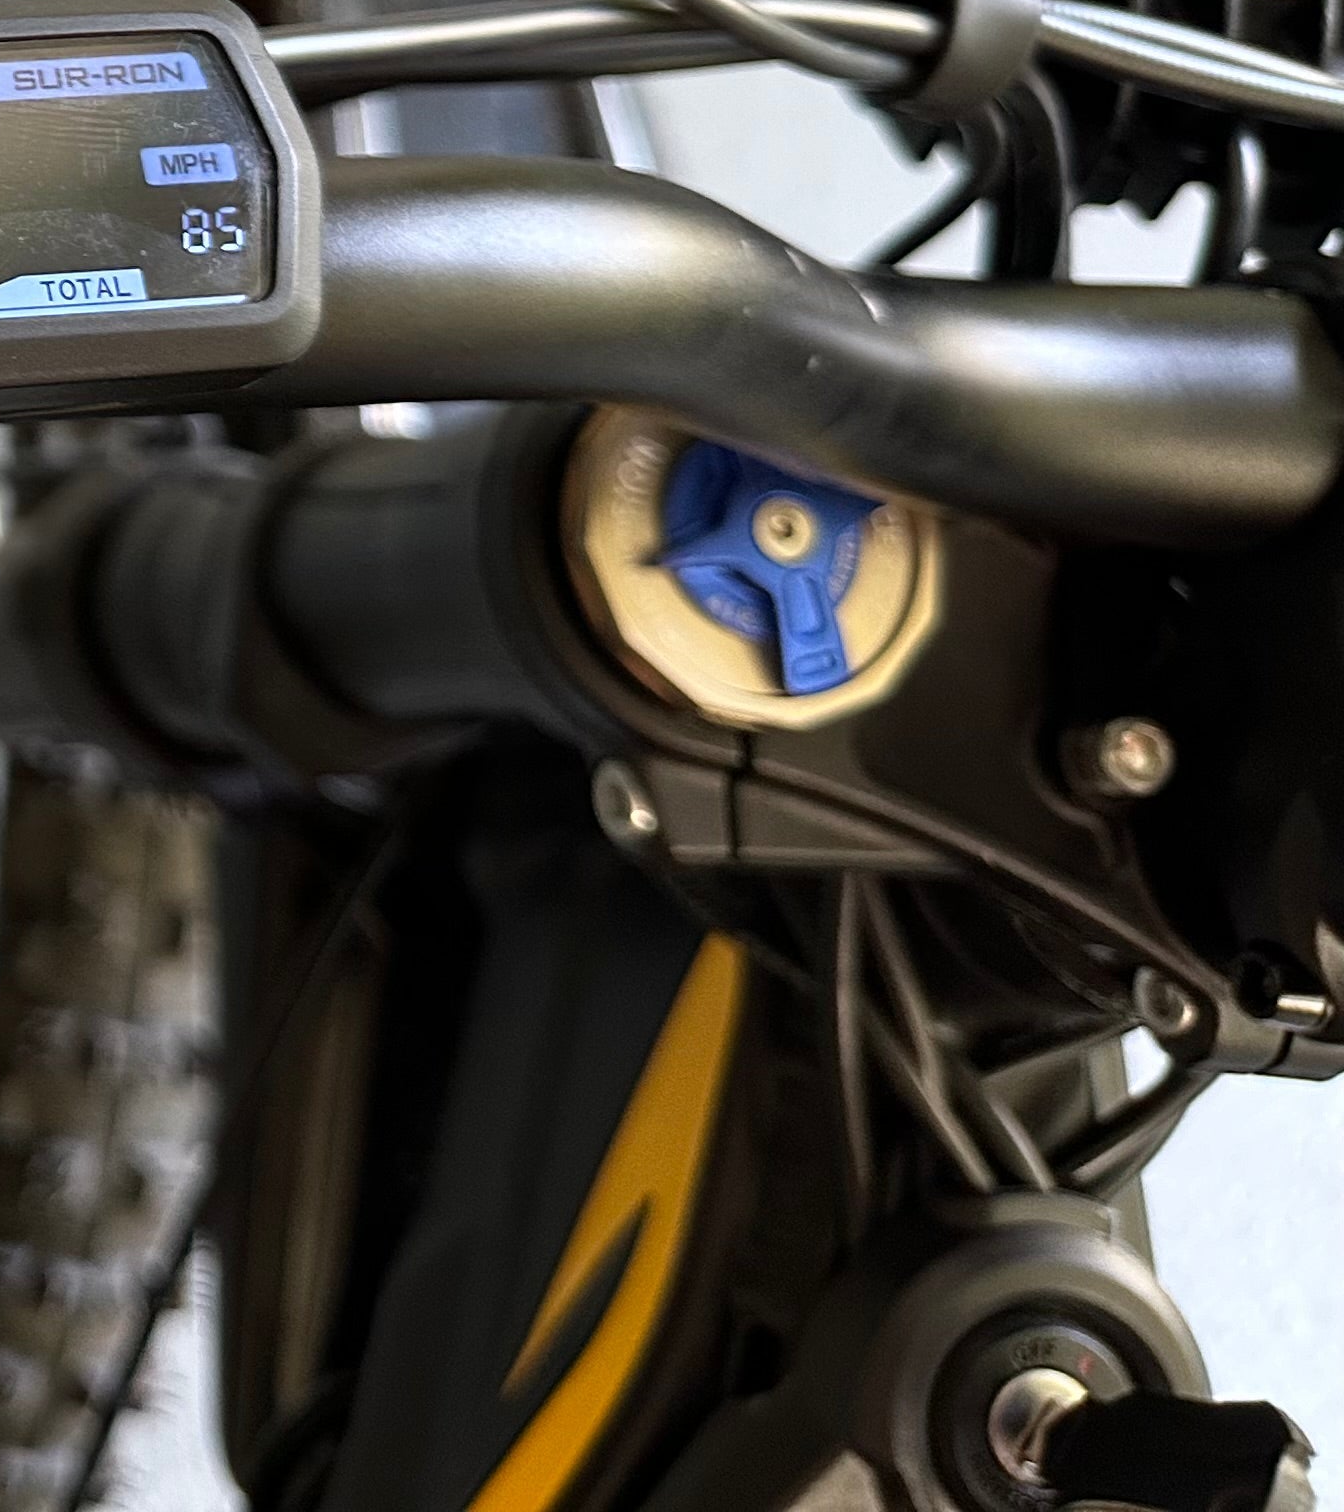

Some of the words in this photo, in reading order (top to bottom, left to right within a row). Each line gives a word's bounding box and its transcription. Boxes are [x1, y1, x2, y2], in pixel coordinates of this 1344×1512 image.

[13, 61, 185, 90] SUR-RON
[159, 151, 220, 175] MPH
[180, 205, 247, 255] 85
[39, 275, 132, 302] TOTAL
